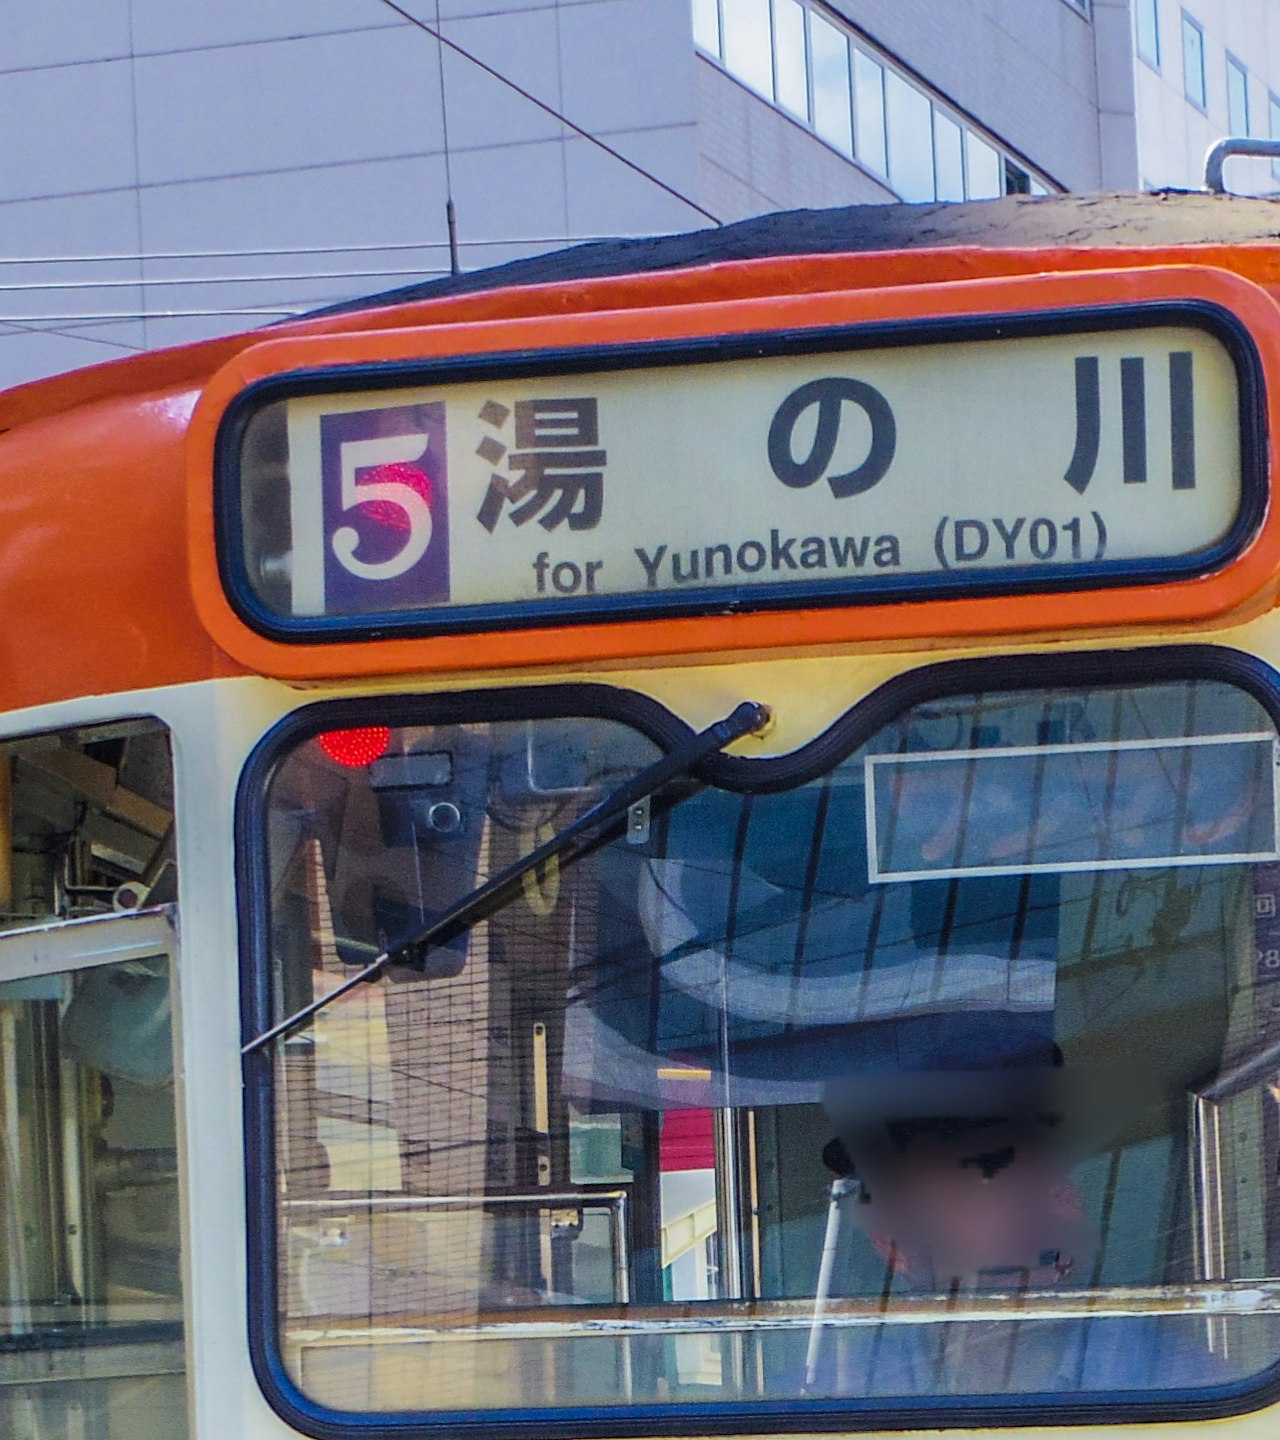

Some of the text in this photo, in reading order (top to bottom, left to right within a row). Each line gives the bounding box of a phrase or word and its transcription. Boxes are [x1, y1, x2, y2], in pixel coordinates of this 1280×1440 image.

[331, 432, 433, 581] 5
[476, 350, 1196, 535] 湯の川
[532, 511, 1108, 594] for Yunokawa (DY01)
